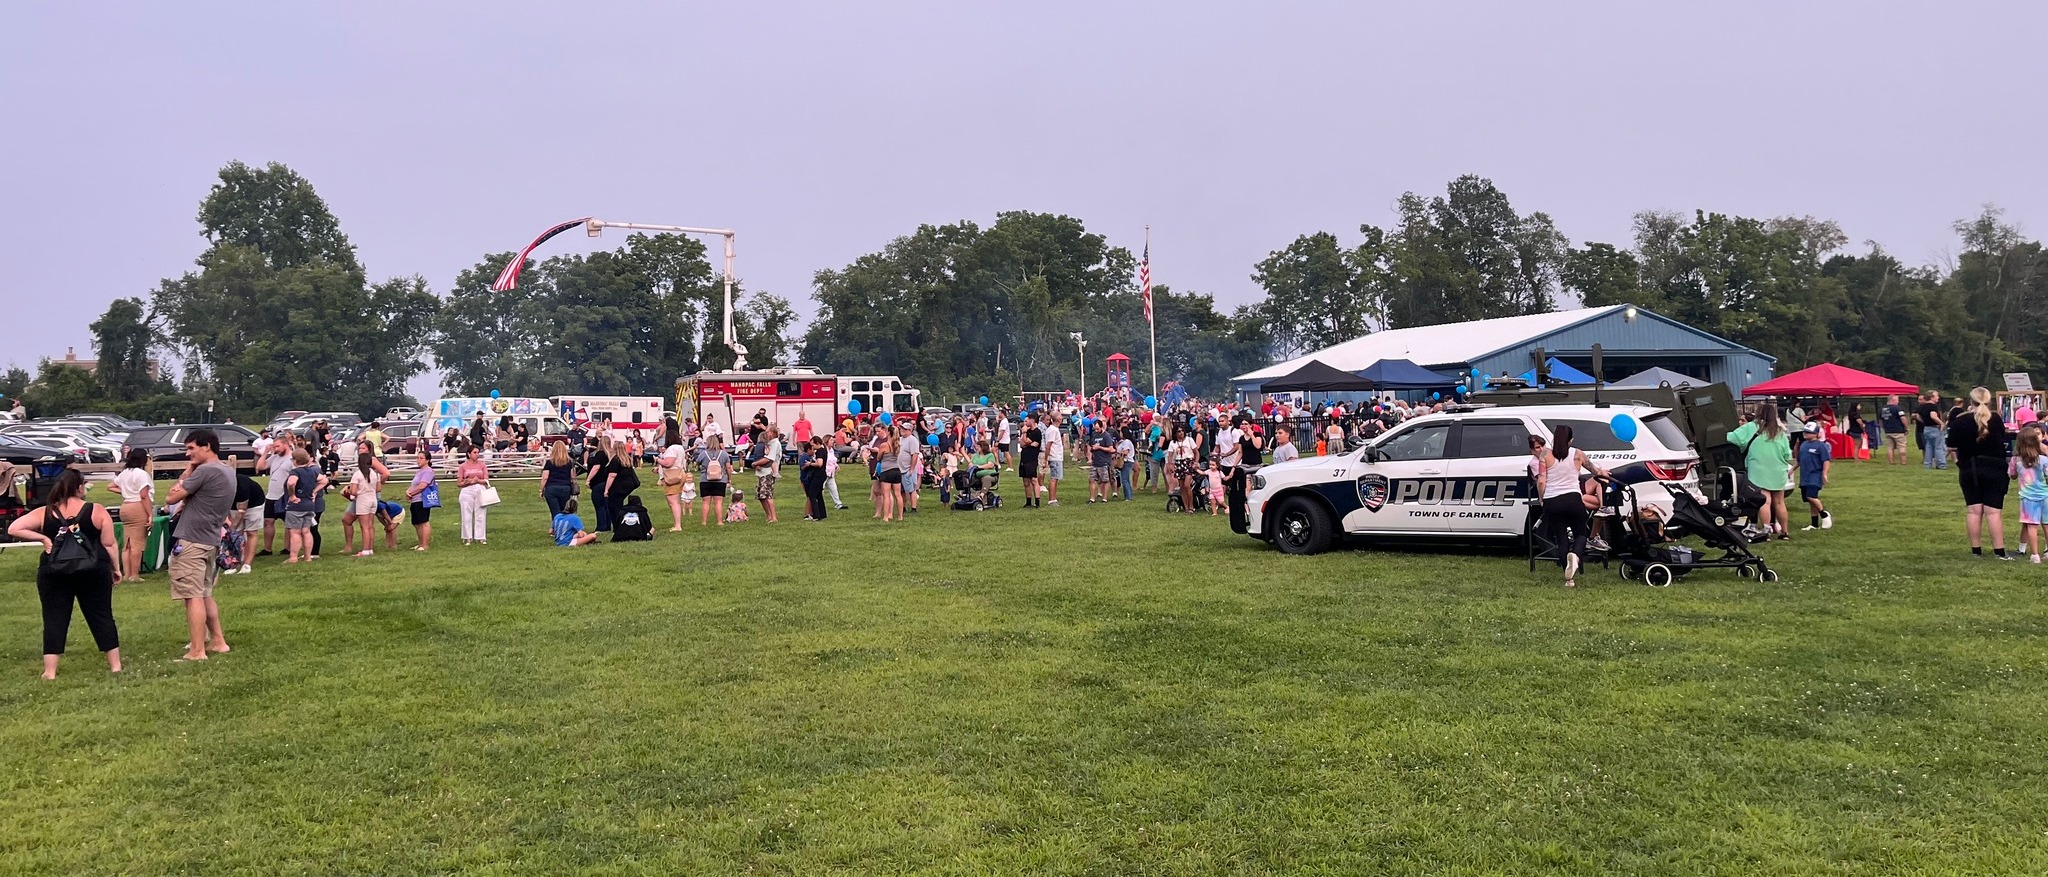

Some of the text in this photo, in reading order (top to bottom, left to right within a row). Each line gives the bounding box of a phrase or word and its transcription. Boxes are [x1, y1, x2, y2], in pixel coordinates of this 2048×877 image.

[1332, 468, 1346, 477] 37
[1394, 480, 1518, 506] POLICE
[1408, 510, 1440, 518] TOWN
[1458, 511, 1505, 519] CARMEL
